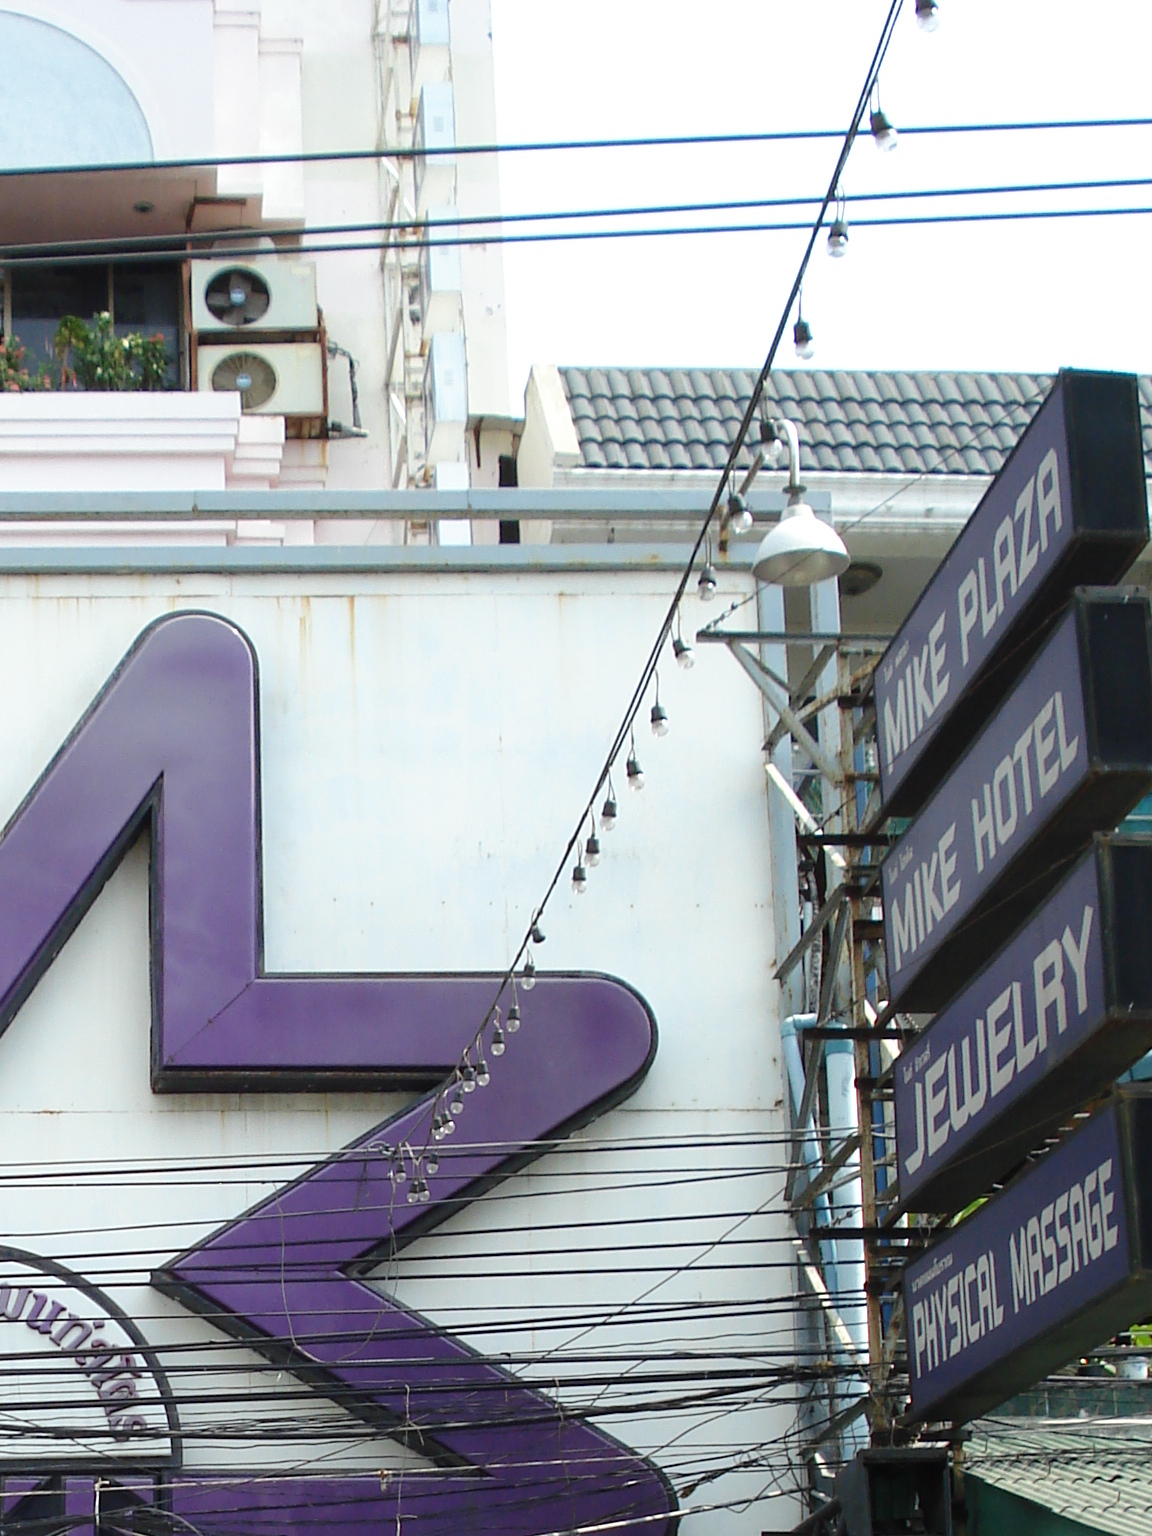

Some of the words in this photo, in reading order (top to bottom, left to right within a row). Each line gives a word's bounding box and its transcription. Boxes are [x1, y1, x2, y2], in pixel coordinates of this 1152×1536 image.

[883, 611, 950, 775] MIKE
[957, 447, 1063, 668] PLAZA
[890, 822, 961, 973] MIKE
[971, 691, 1079, 875] HOTEL
[904, 905, 1094, 1176] JEWELRY
[912, 1250, 1005, 1379] PHYSICAL
[1009, 1158, 1119, 1314] MASSAGE
